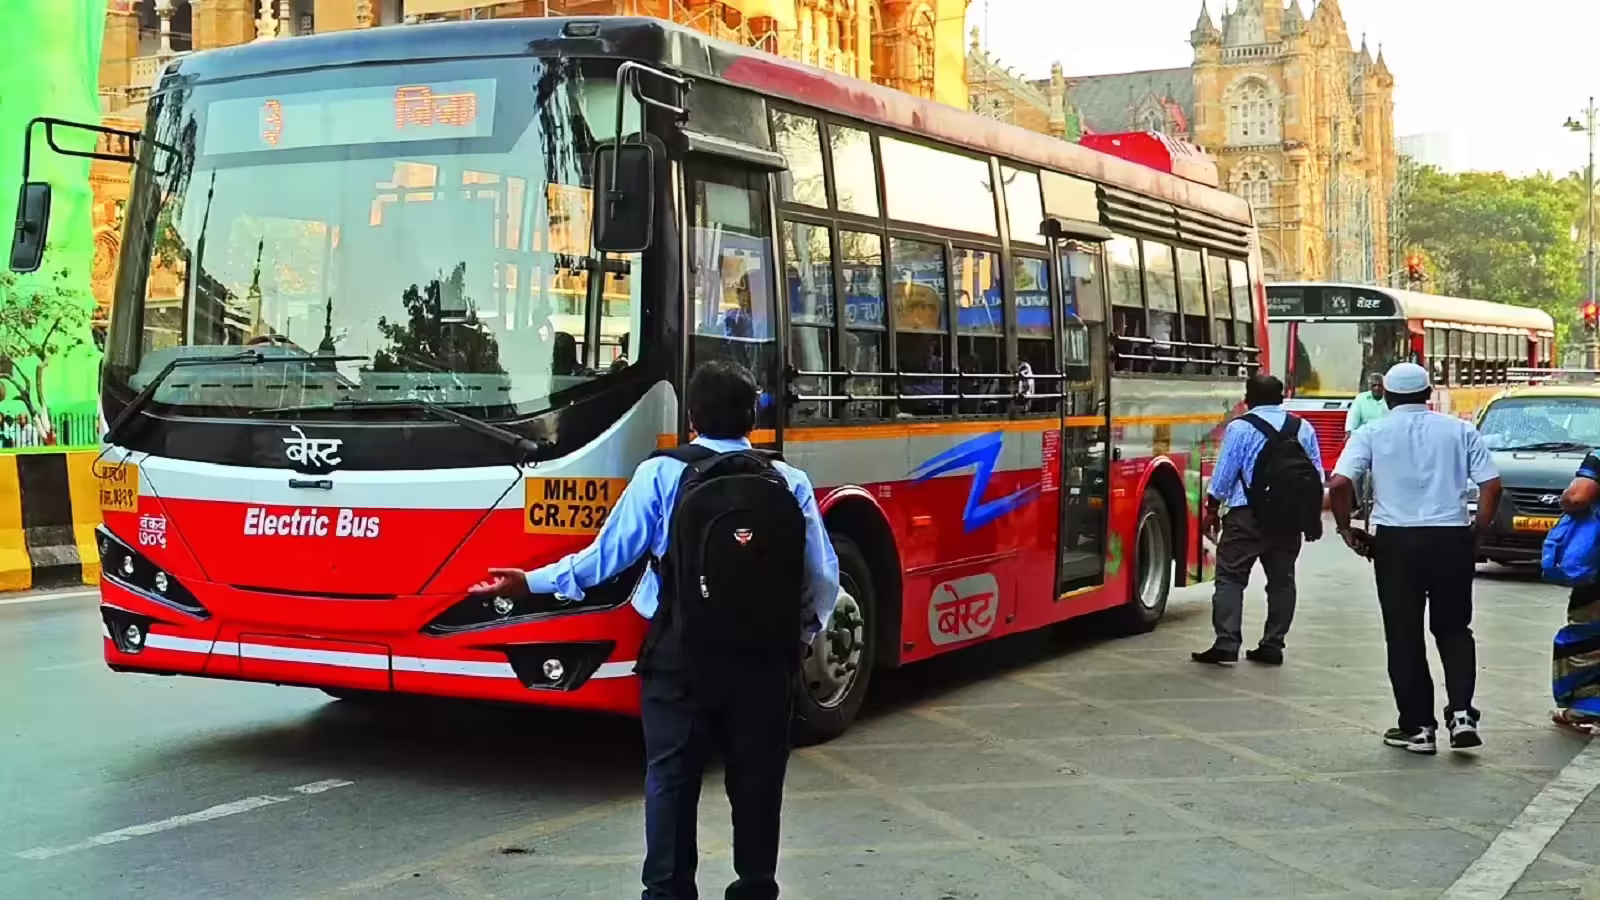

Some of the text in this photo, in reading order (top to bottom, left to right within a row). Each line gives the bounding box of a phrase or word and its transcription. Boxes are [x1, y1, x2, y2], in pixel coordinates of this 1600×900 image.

[282, 424, 344, 467] बेस्ट
[544, 479, 609, 502] MH.01
[244, 507, 380, 538] Electric Bus
[529, 502, 608, 528] CR.732
[933, 584, 995, 635] बेस्ट
